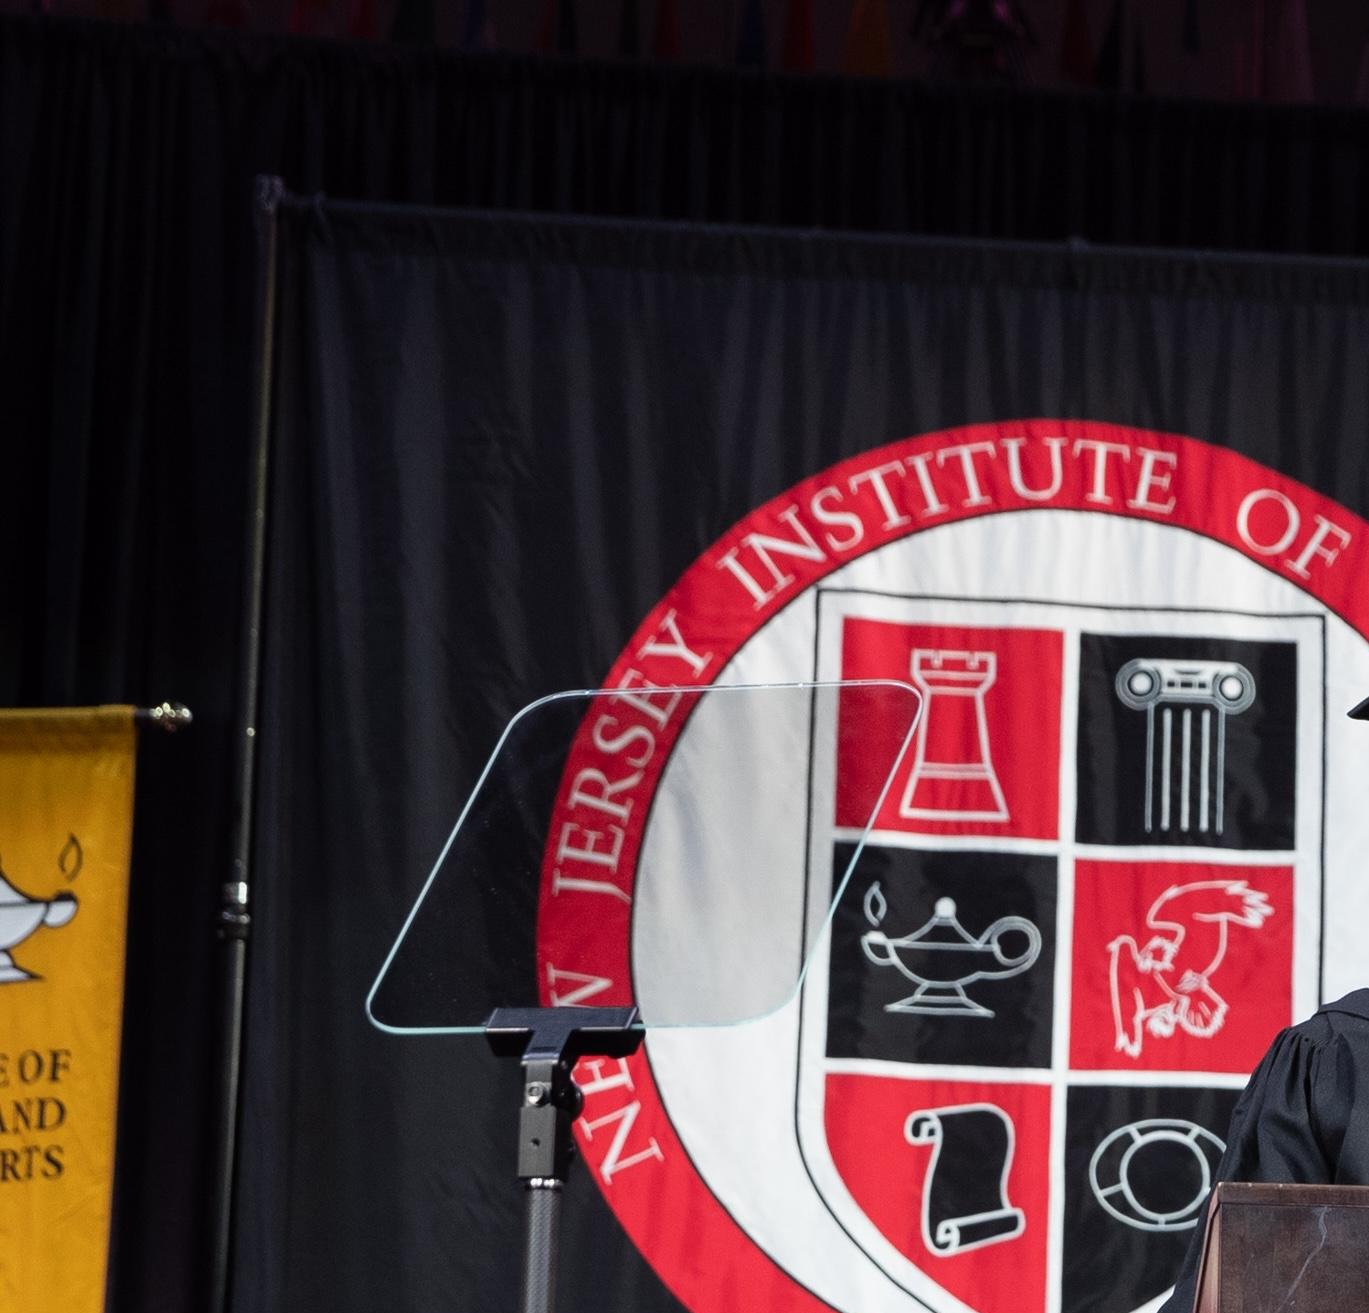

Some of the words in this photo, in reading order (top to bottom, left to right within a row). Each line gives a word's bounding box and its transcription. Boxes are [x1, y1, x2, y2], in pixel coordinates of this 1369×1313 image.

[552, 609, 712, 902] JERSEY
[717, 436, 1178, 610] INSTITUTE
[1237, 488, 1350, 580] OF
[17, 1049, 72, 1084] OF
[0, 1145, 64, 1182] RTS
